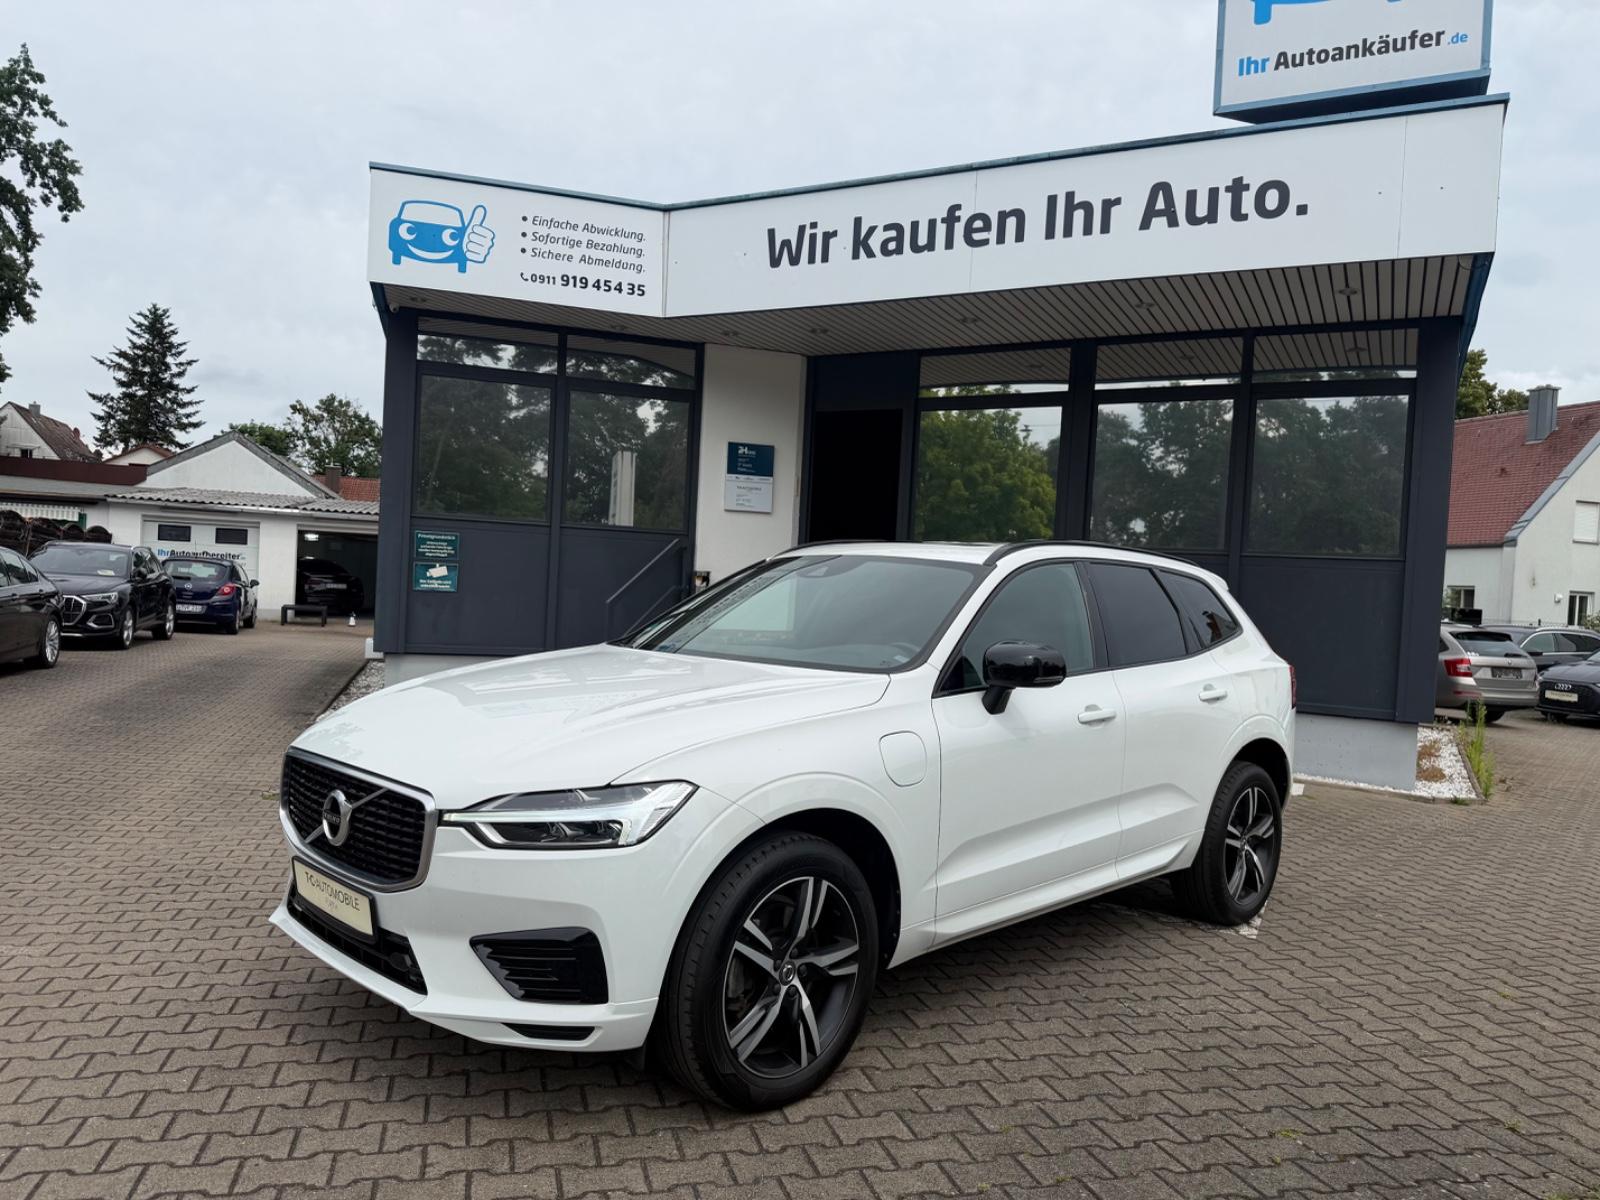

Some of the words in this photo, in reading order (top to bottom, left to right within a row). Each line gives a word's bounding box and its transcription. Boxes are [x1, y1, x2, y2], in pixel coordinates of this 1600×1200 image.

[1238, 56, 1269, 76] Ihr
[531, 215, 579, 231] Einfache
[581, 222, 646, 243] Abwicklung.
[767, 221, 838, 268] Wir
[851, 203, 1025, 260] kaufen
[1045, 190, 1122, 240] Ihr
[1138, 176, 1308, 231] Auto.
[530, 231, 583, 249] Sofortige
[585, 239, 646, 258] Bezahlung.
[530, 247, 574, 262] Sichere
[578, 254, 646, 274] Abmeldung.
[530, 273, 556, 285] 0911
[560, 274, 589, 289] 919
